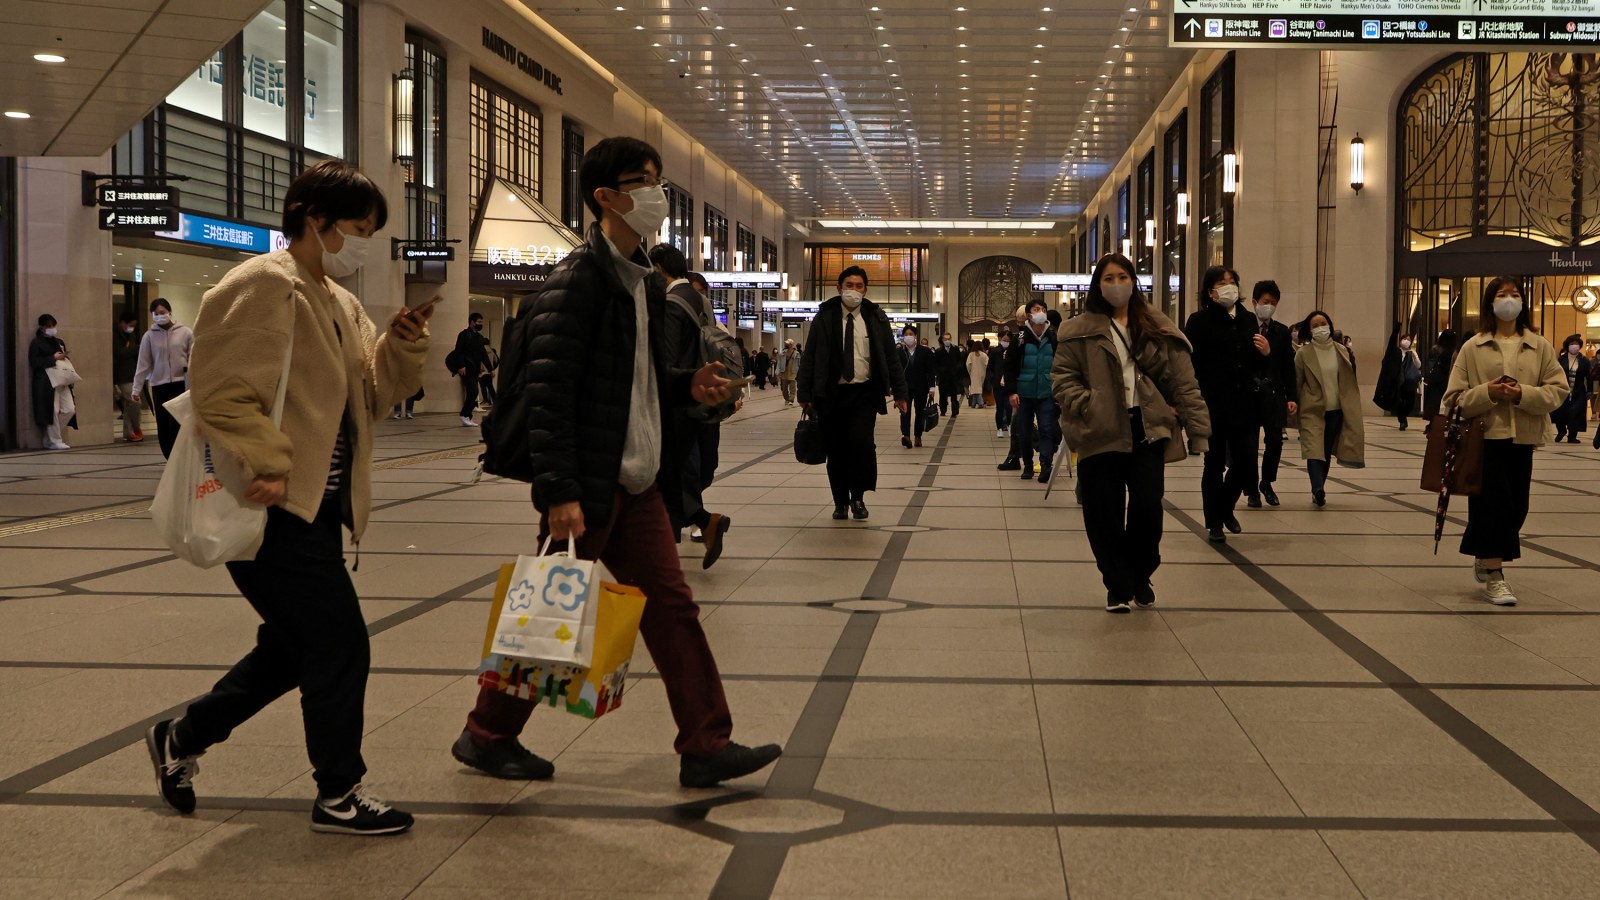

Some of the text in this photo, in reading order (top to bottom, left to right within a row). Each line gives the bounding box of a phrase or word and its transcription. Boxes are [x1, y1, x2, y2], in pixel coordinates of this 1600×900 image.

[1199, 0, 1218, 9] Hankyu
[1490, 3, 1511, 11] Hankyu
[1225, 20, 1259, 29] 阪神電車
[1289, 20, 1315, 29] 谷町線
[1383, 21, 1416, 30] 四つ橋線
[1479, 22, 1523, 31] JR北新地駅
[1225, 29, 1261, 37] Hanshin Line
[1289, 30, 1355, 39] Subway Tanimachi Line
[1383, 31, 1451, 40] Subway Yotsubashi Line
[1479, 31, 1540, 39] JR Kitashinchi Station
[1550, 32, 1597, 42] Subway Midosuji
[482, 26, 516, 65] HANKYU
[517, 51, 543, 82] GRAND
[118, 192, 168, 201] 三井住友信託銀行
[118, 215, 167, 225] 三井住友銀行
[203, 224, 254, 246] 三井住友信託銀行
[1549, 251, 1593, 272] Hankyu
[494, 273, 547, 282] HANKYU GRA
